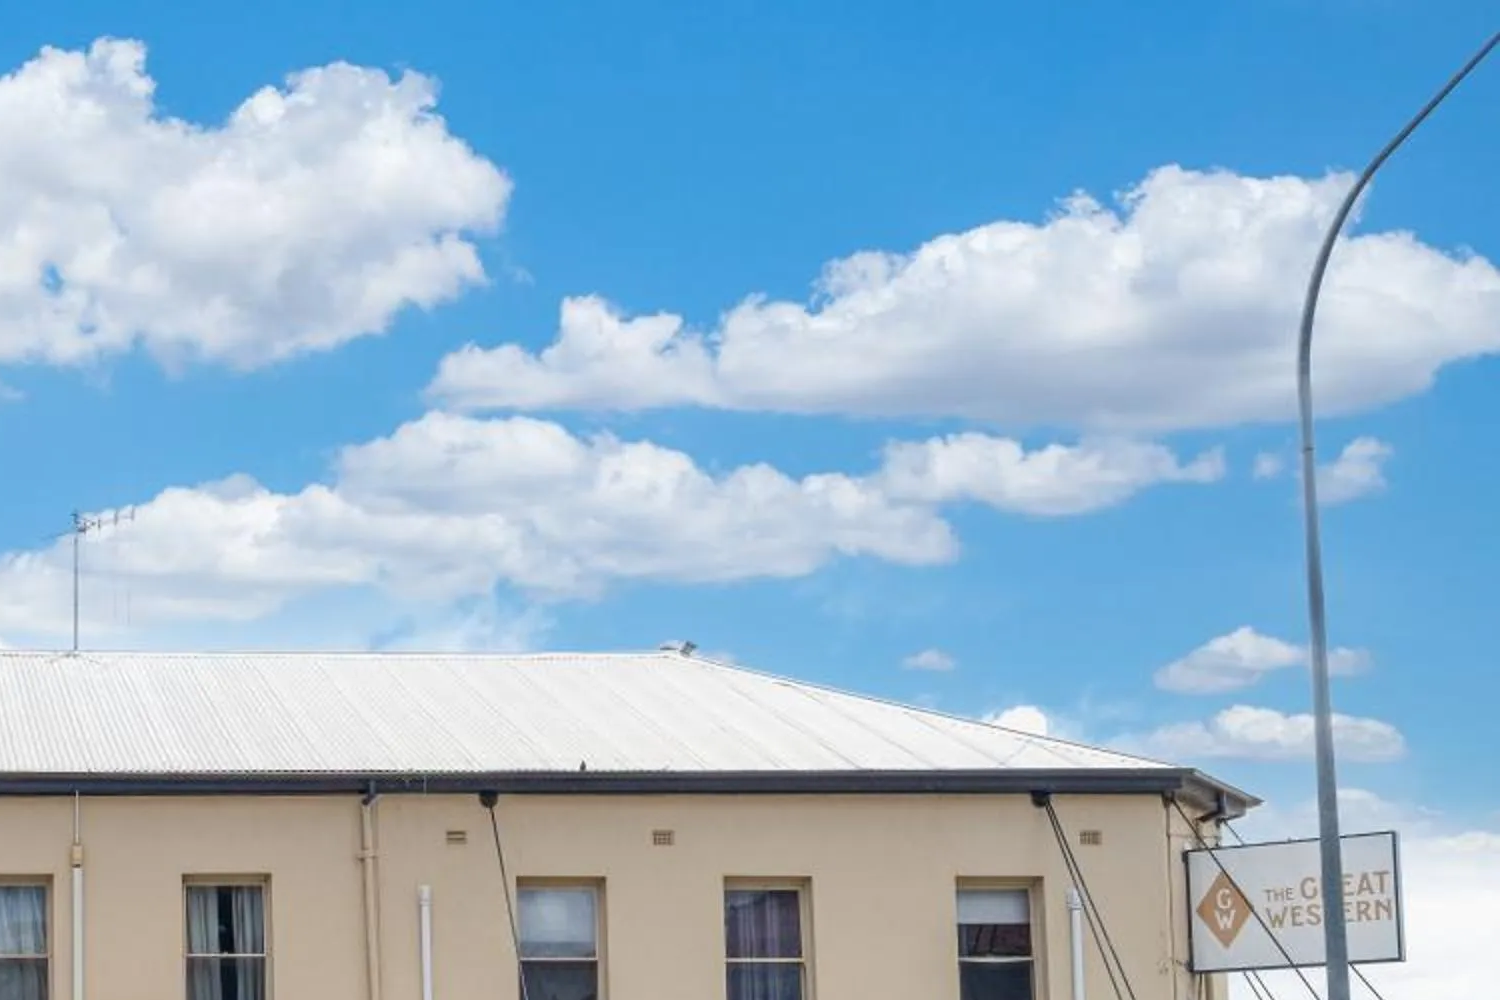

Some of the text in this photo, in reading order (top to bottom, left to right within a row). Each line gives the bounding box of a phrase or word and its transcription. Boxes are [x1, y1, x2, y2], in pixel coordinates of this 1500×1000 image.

[1216, 888, 1233, 909] G
[1265, 871, 1391, 903] THE GEAT
[1214, 908, 1236, 930] W
[1266, 898, 1393, 929] WESERN
